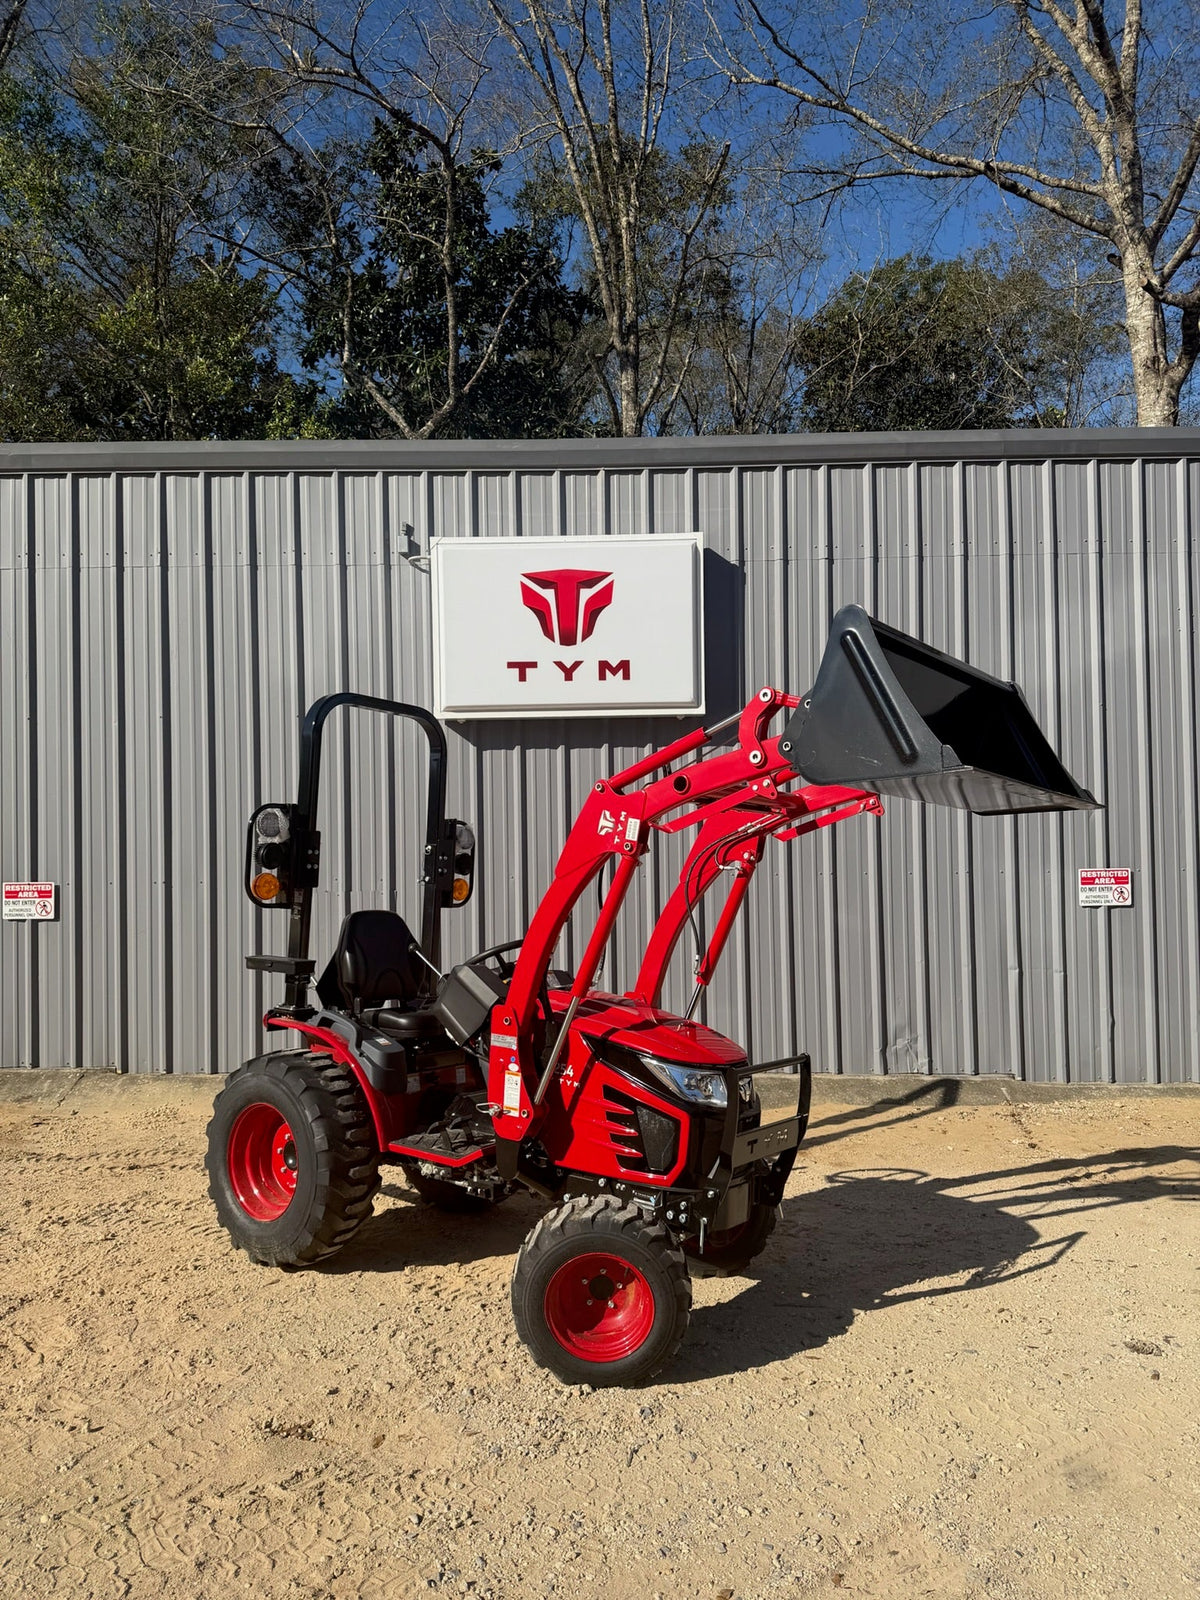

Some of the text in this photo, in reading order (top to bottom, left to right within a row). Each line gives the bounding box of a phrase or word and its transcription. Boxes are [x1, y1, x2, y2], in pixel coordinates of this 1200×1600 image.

[506, 659, 631, 682] TYM
[613, 811, 627, 844] TYM
[558, 1078, 581, 1088] TYM
